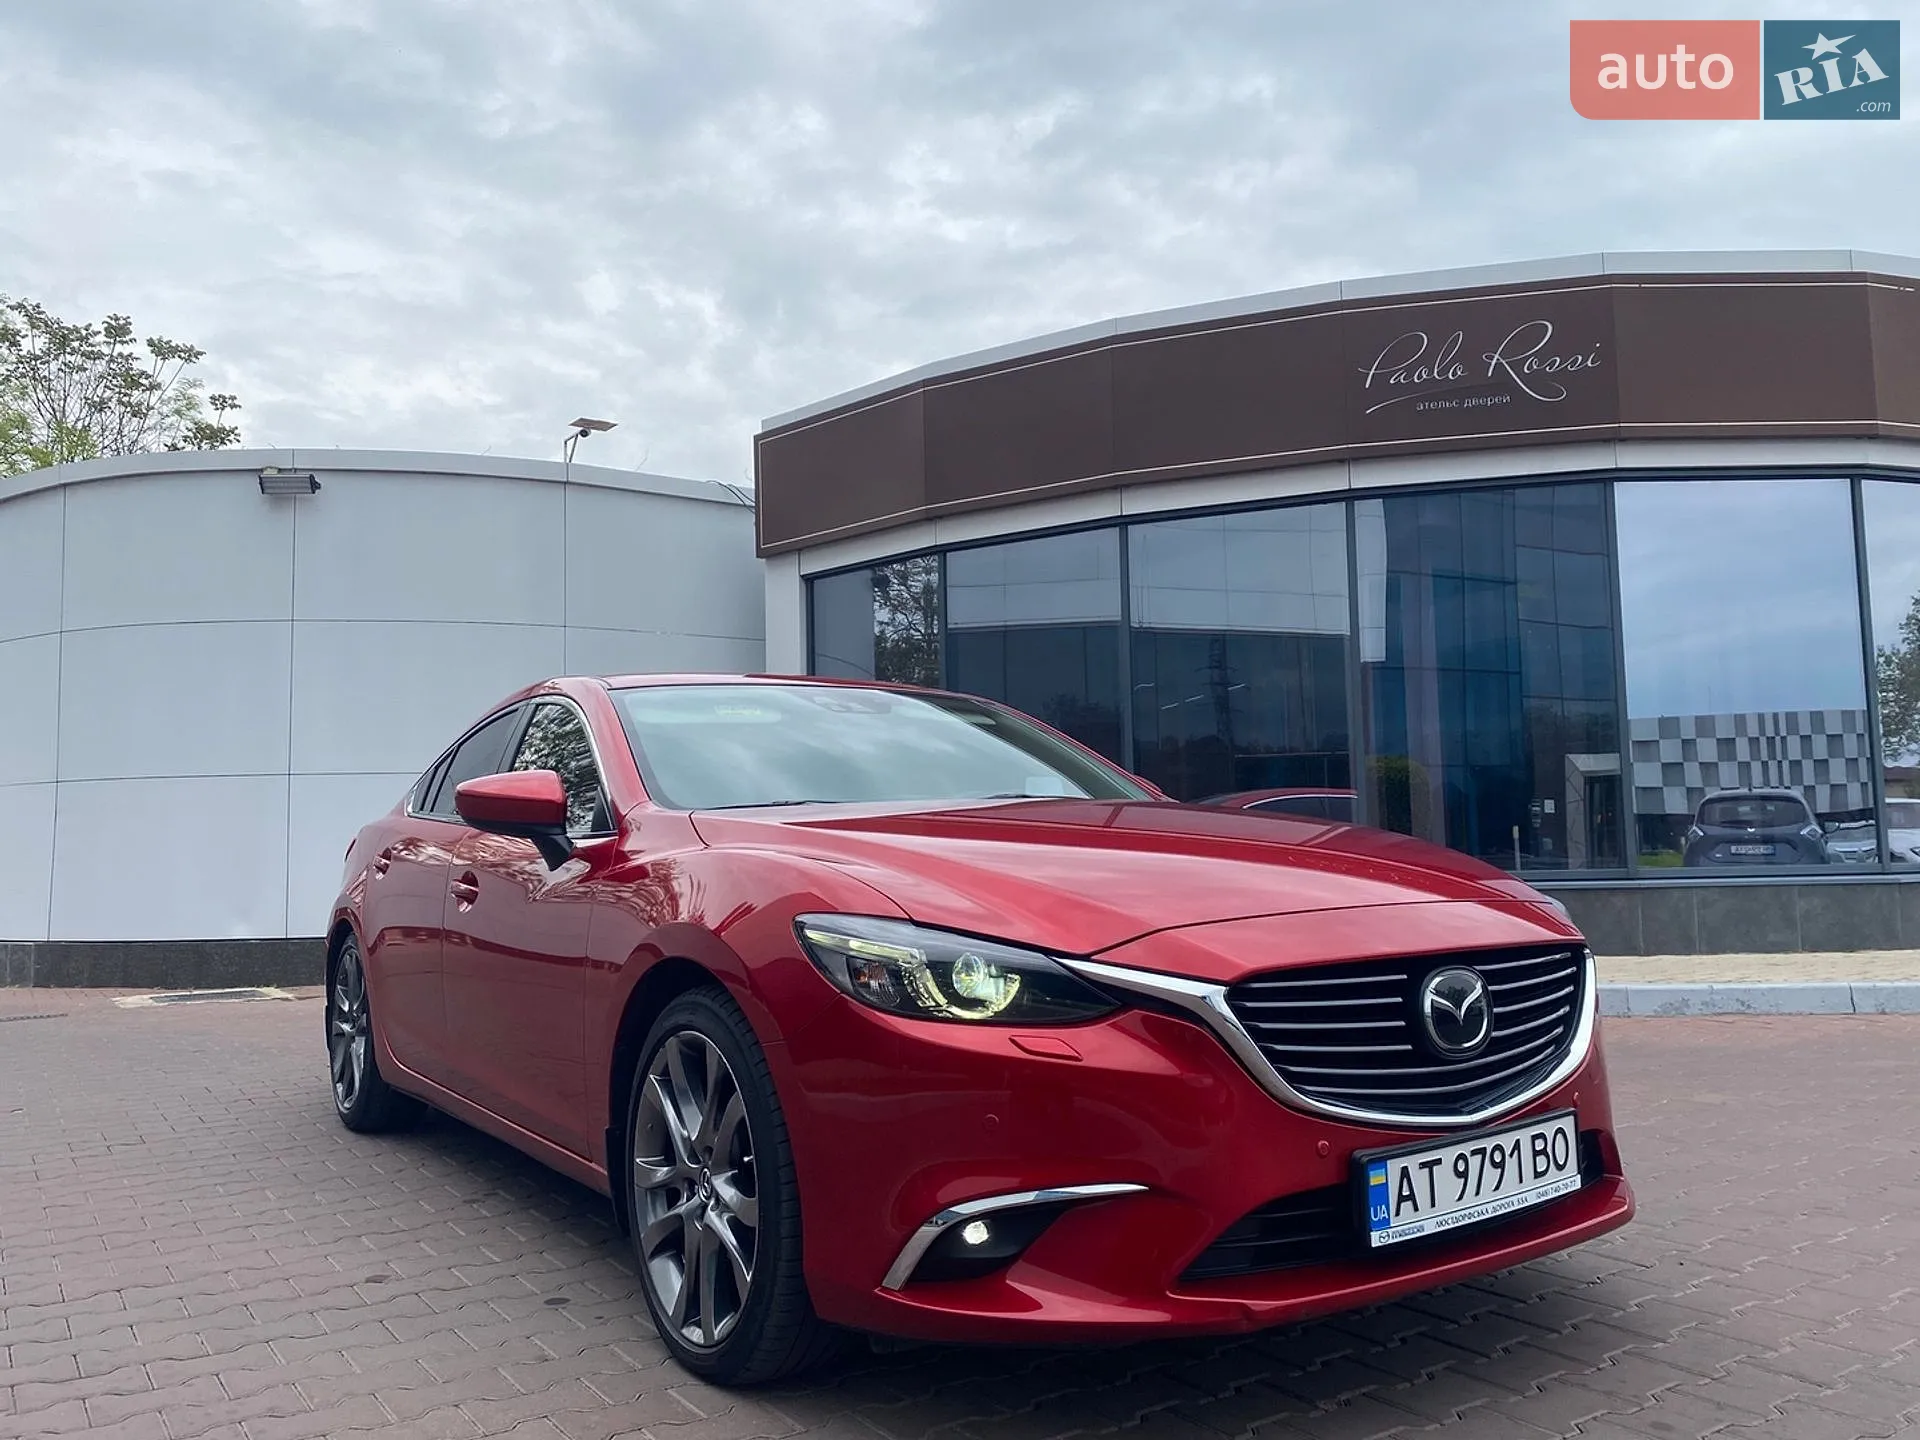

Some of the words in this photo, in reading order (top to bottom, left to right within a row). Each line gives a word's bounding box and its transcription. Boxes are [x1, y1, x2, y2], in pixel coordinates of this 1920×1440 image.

[1357, 331, 1468, 389] Paolo
[1482, 320, 1601, 401] Rossi
[1463, 394, 1511, 408] дверей
[1394, 1157, 1443, 1217] AT
[1453, 1138, 1524, 1202] 9791
[1371, 1208, 1389, 1222] UA
